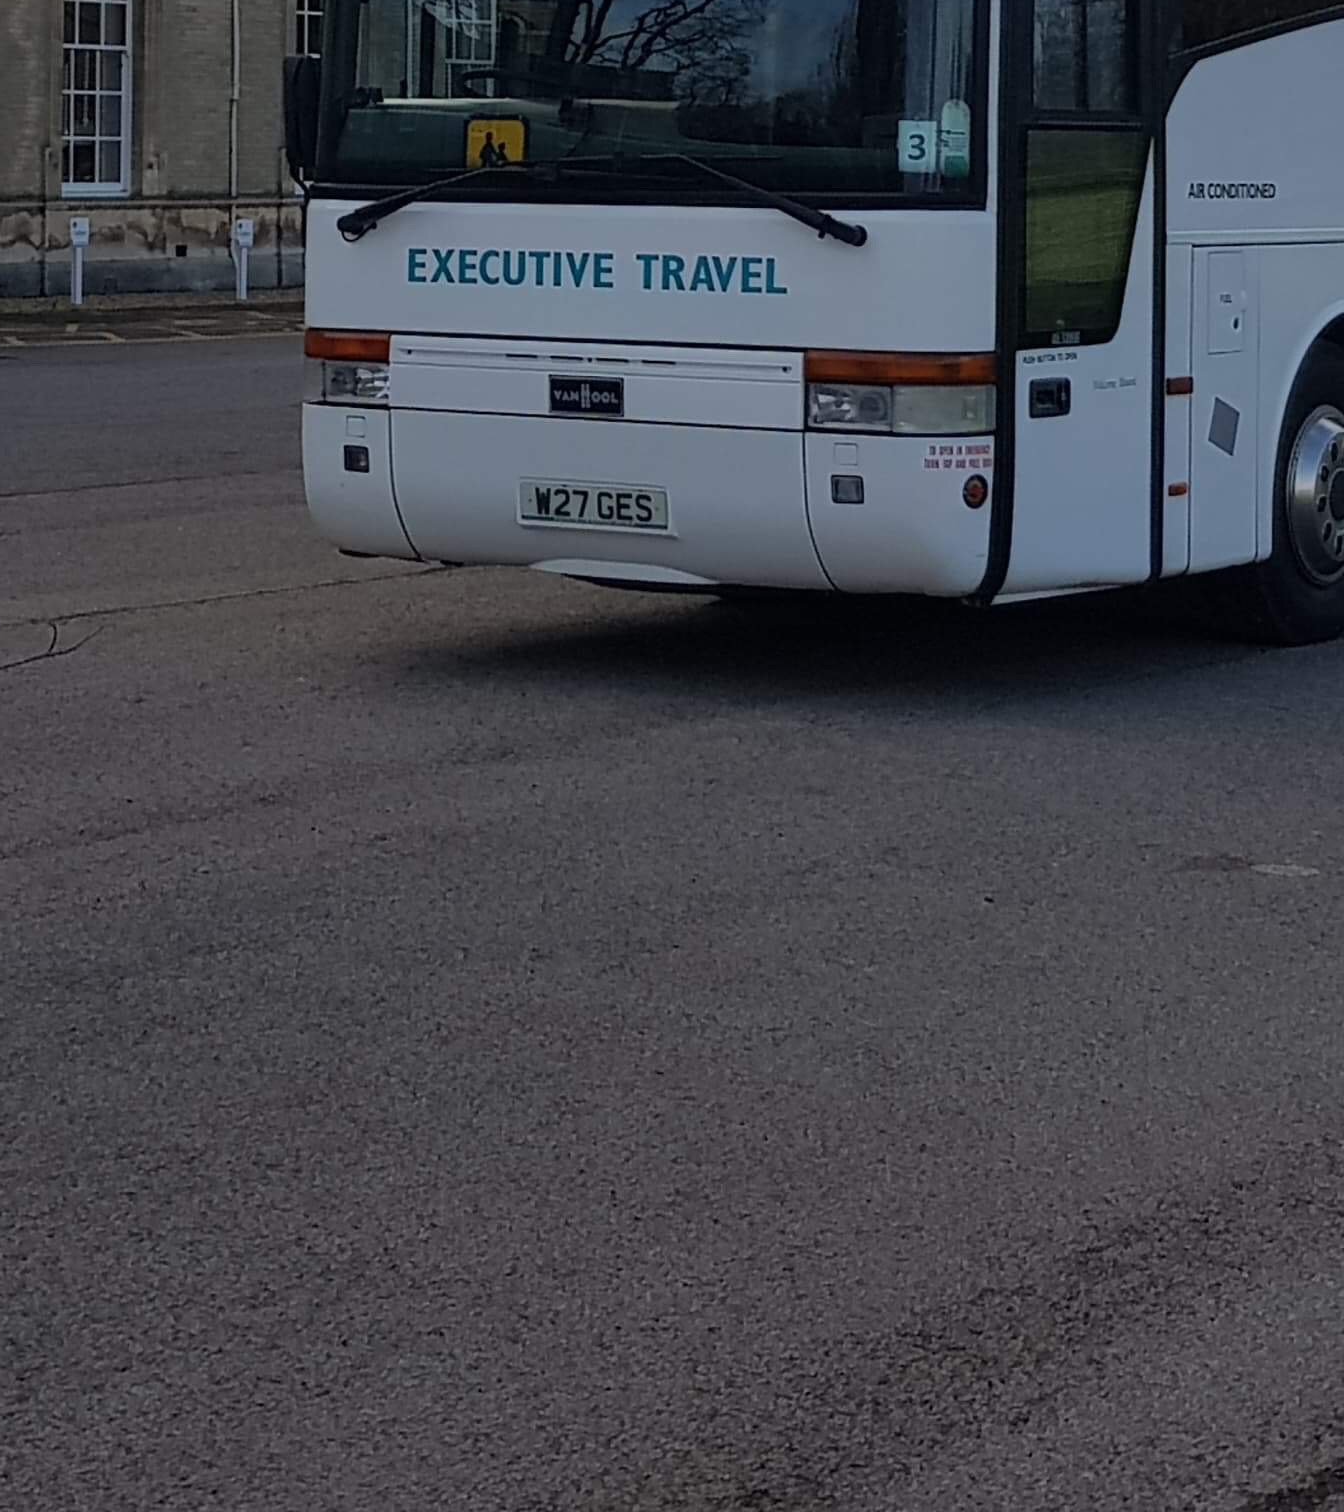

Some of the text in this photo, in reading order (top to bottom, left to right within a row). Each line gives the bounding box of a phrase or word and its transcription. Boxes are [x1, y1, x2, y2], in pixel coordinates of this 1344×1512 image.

[908, 133, 926, 161] 3
[1188, 183, 1276, 199] AIR CONDITIONED
[407, 248, 788, 295] EXECUTIVE TRAVEL
[534, 486, 653, 523] W27 GES
